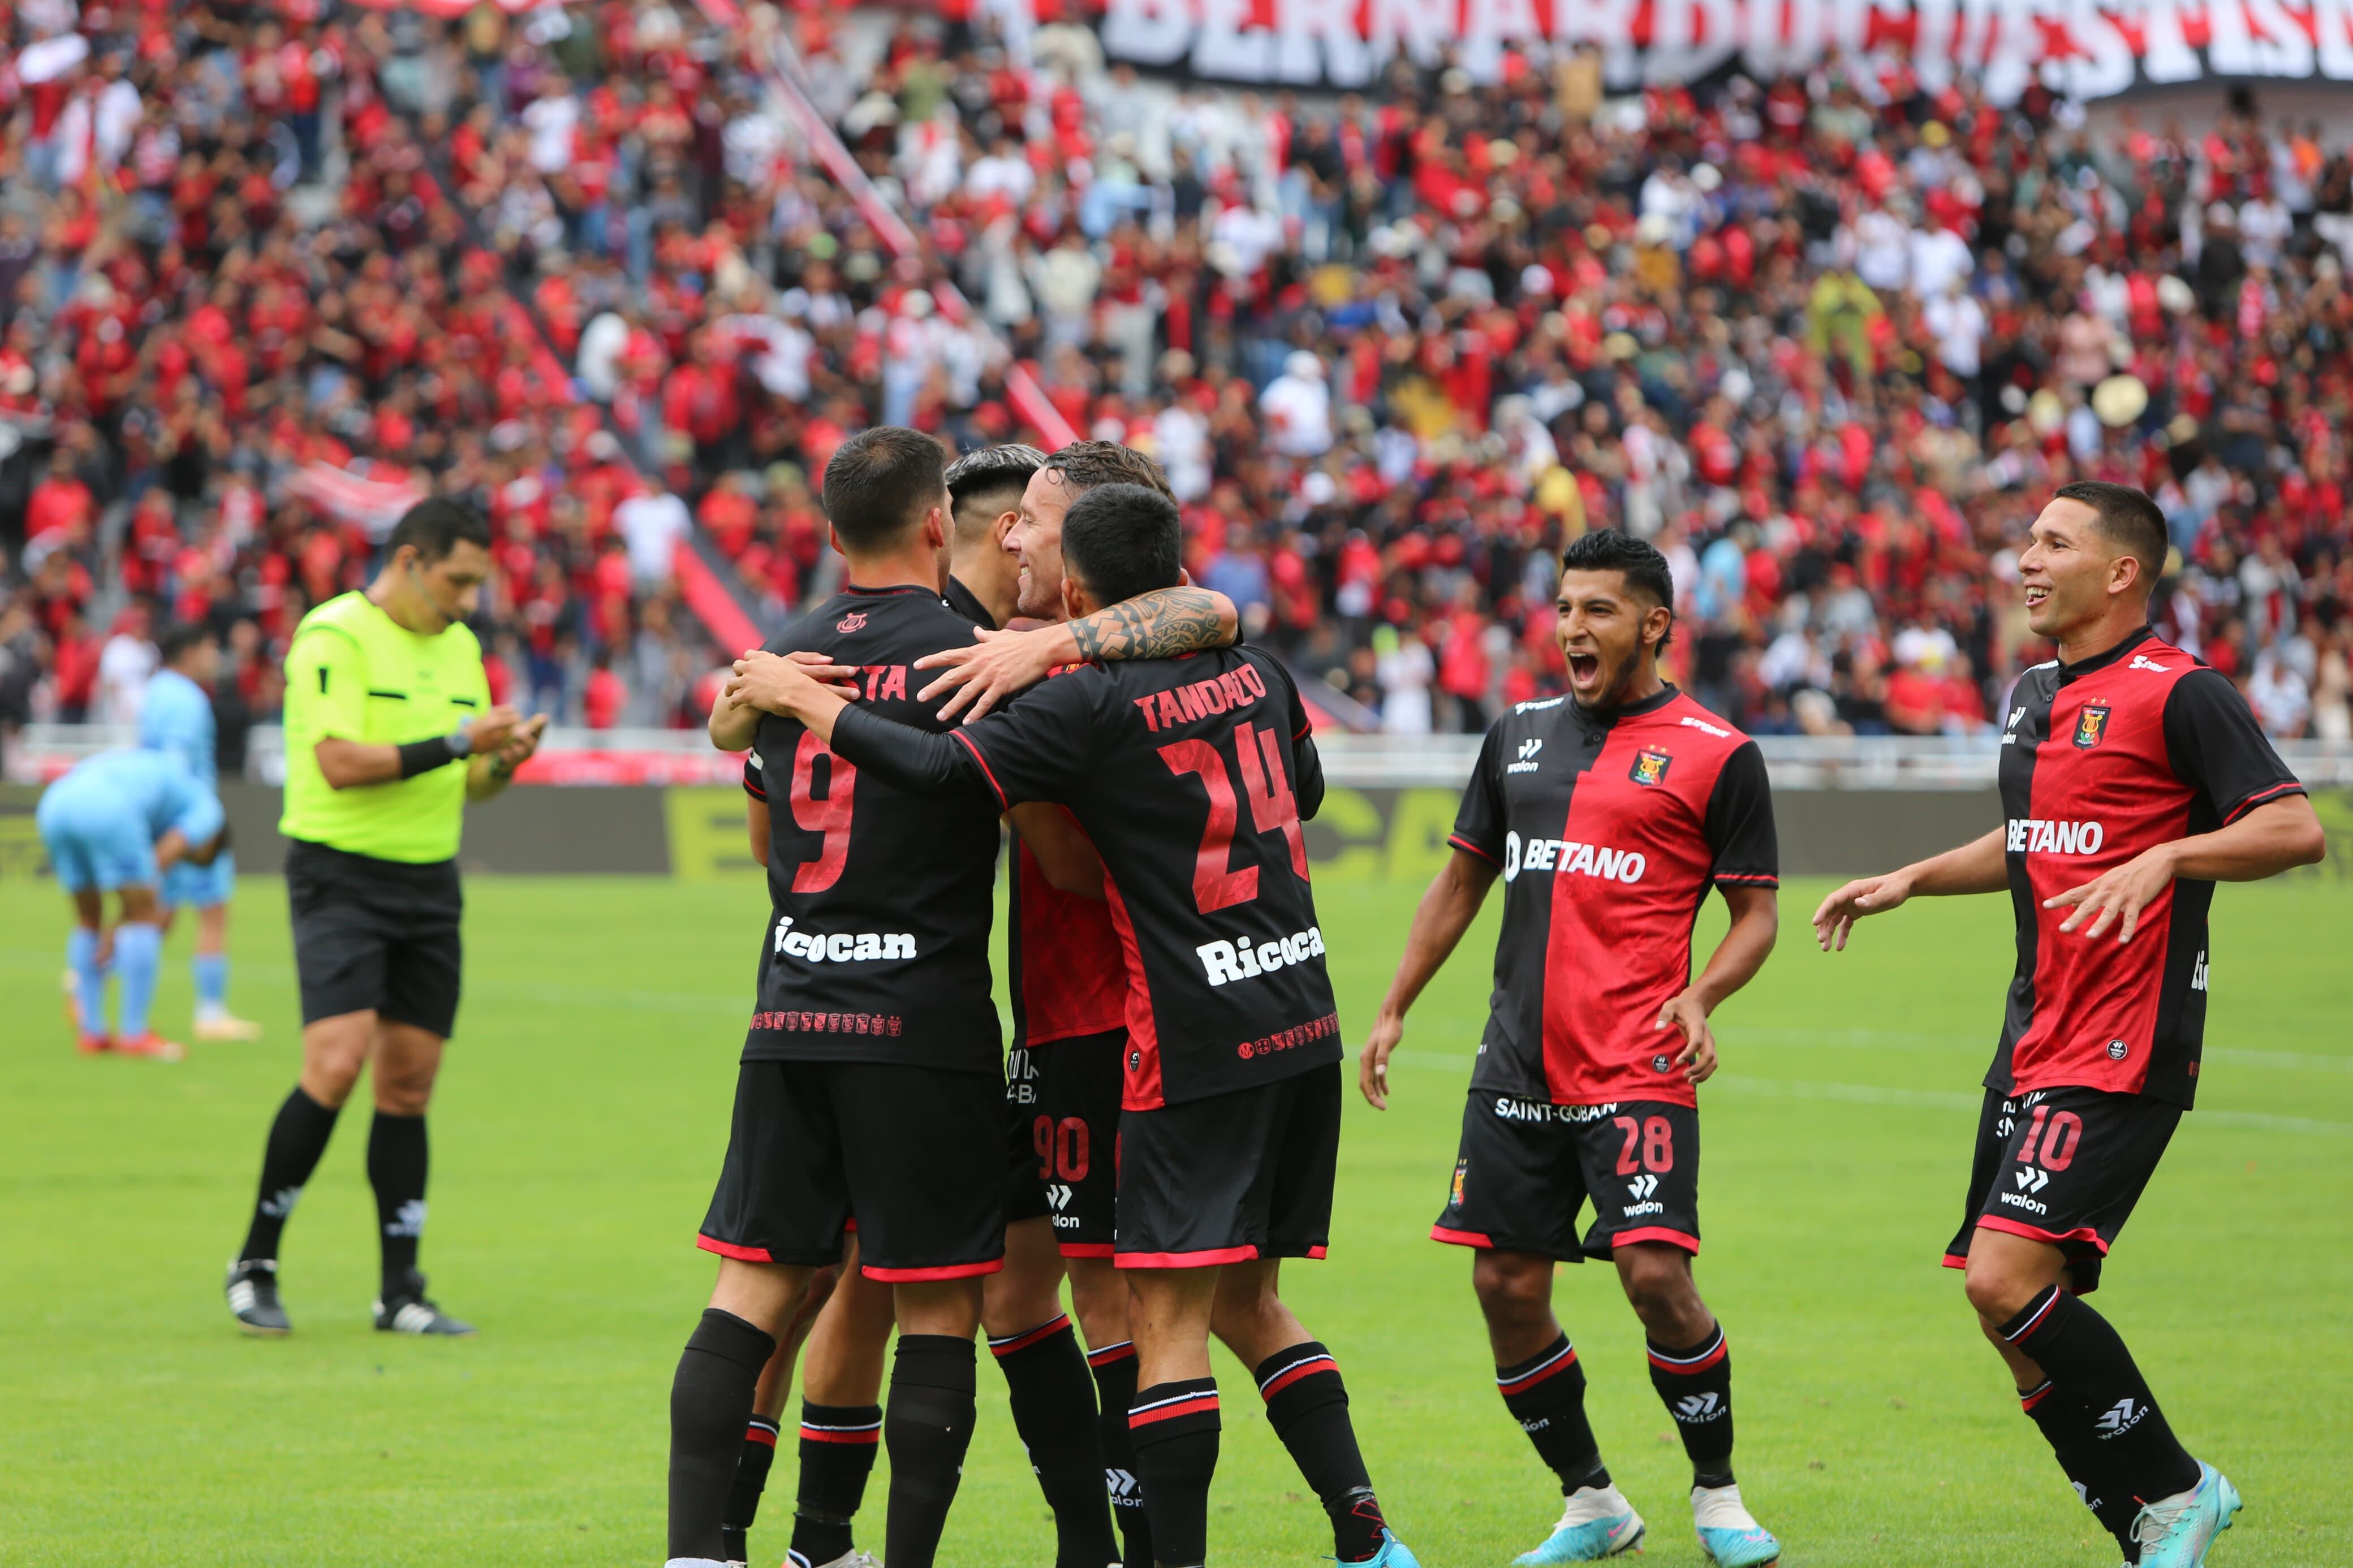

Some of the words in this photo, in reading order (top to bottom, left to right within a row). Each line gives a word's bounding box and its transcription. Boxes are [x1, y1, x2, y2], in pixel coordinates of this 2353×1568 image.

[1507, 759, 1539, 775] walon
[790, 729, 856, 893] 9
[1157, 721, 1310, 915] 24
[2007, 818, 2104, 855] BETANO
[1523, 838, 1647, 884] BETANO
[774, 915, 917, 962] icocan
[1196, 926, 1325, 986] Ricoca
[1033, 1115, 1089, 1182] 90
[1613, 1116, 1673, 1177] 28
[2016, 1105, 2083, 1172] 10
[1052, 1213, 1080, 1228] alon
[1623, 1200, 1664, 1218] walon
[2001, 1191, 2048, 1216] walon
[2097, 1405, 2149, 1440] walon
[1110, 1494, 1144, 1507] alon
